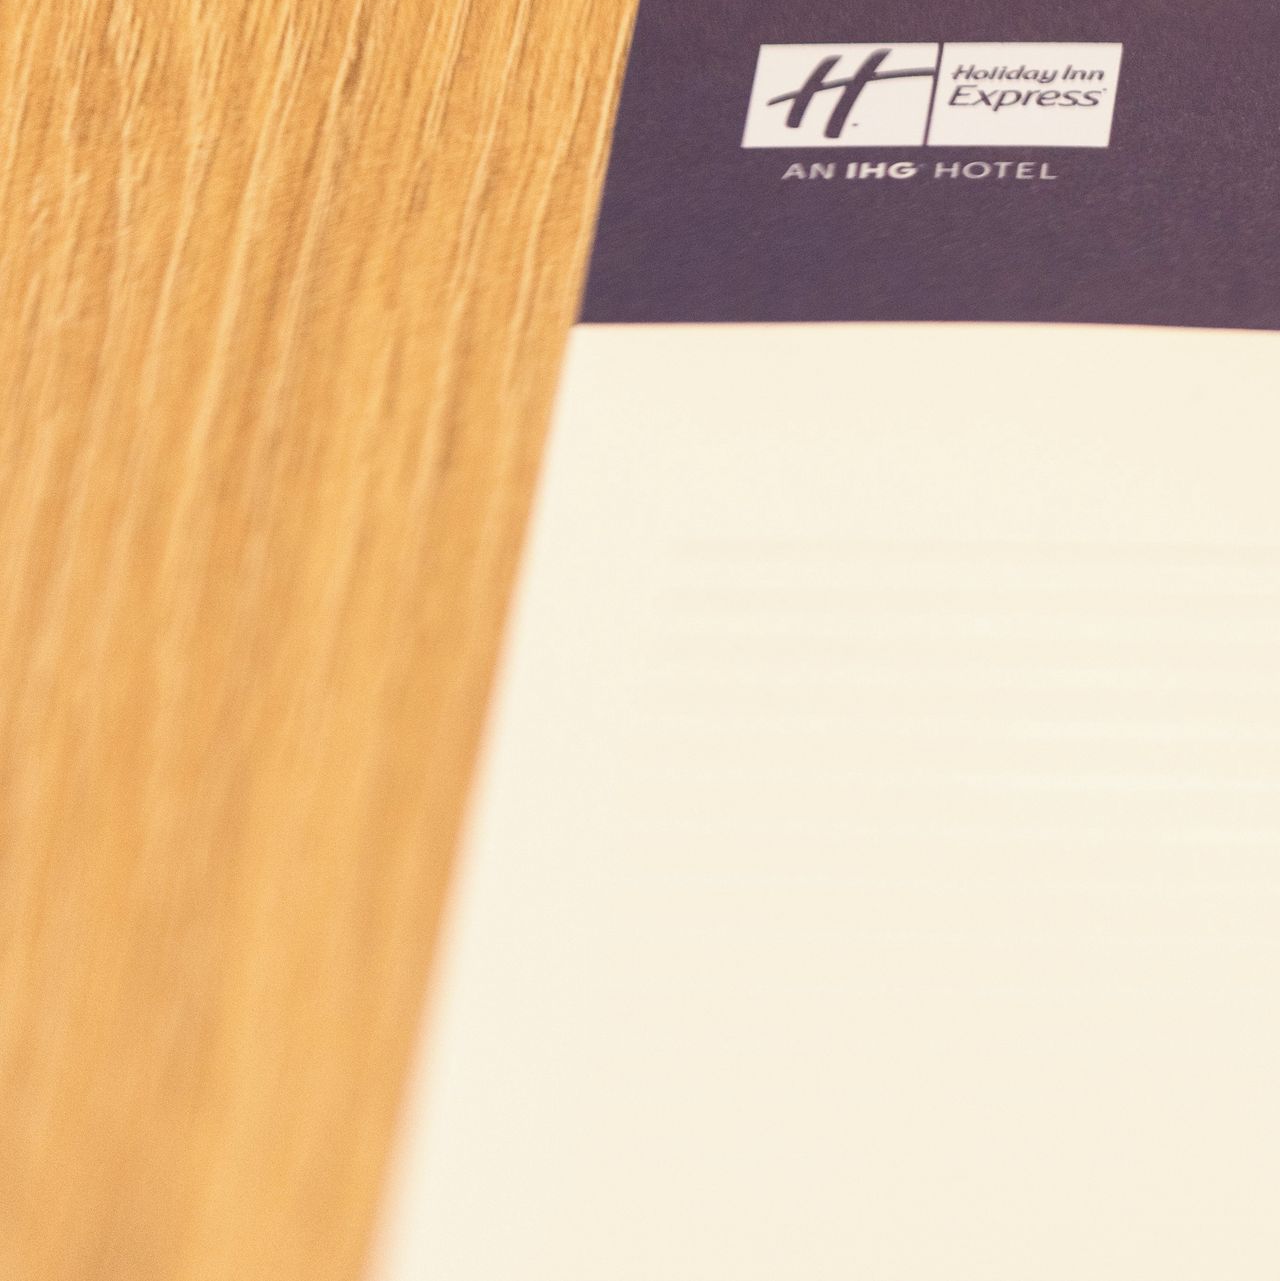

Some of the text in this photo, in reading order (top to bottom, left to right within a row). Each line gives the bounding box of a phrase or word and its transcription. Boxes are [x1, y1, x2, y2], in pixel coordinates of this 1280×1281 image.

[951, 63, 1105, 84] Holiday Inn
[948, 84, 1101, 112] Express
[781, 161, 1058, 181] AN IHG HOTEL
